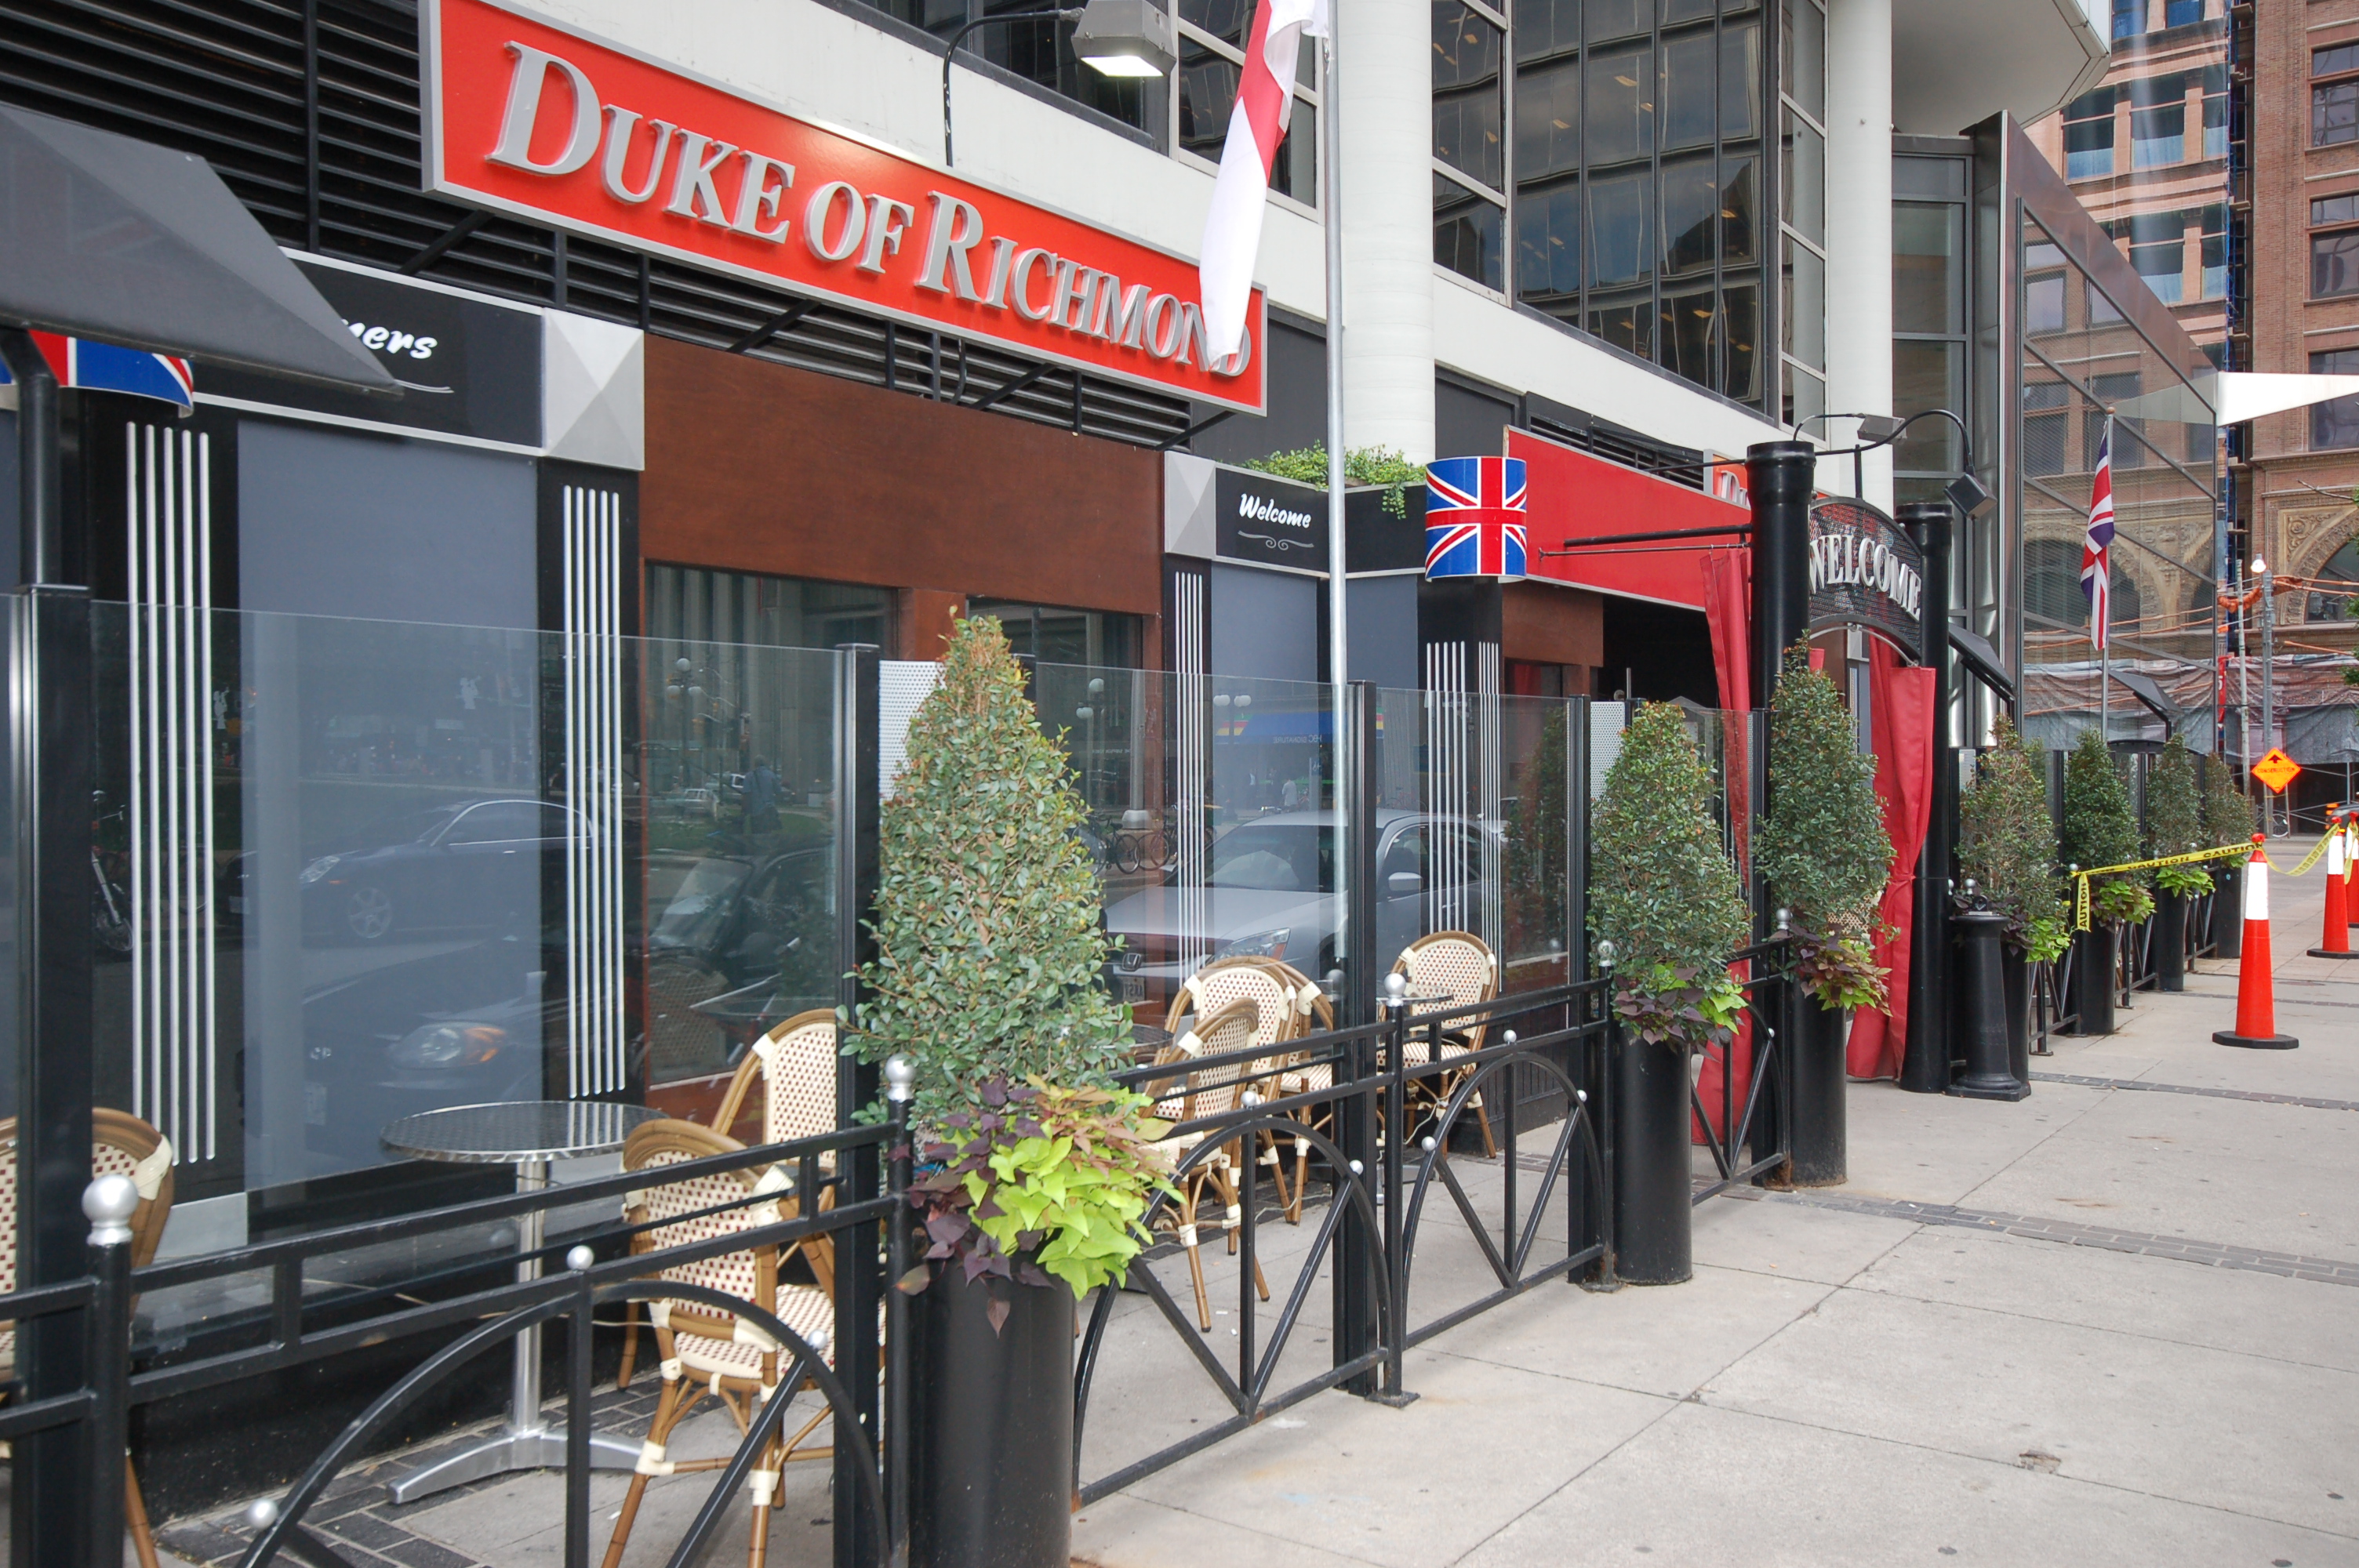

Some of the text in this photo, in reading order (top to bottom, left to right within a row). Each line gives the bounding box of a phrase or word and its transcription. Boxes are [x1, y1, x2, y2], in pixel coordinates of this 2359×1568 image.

[485, 41, 795, 245] DUKE
[803, 181, 914, 274] OF
[1239, 493, 1311, 528] Welcome
[1810, 535, 1921, 622] WELCOME
